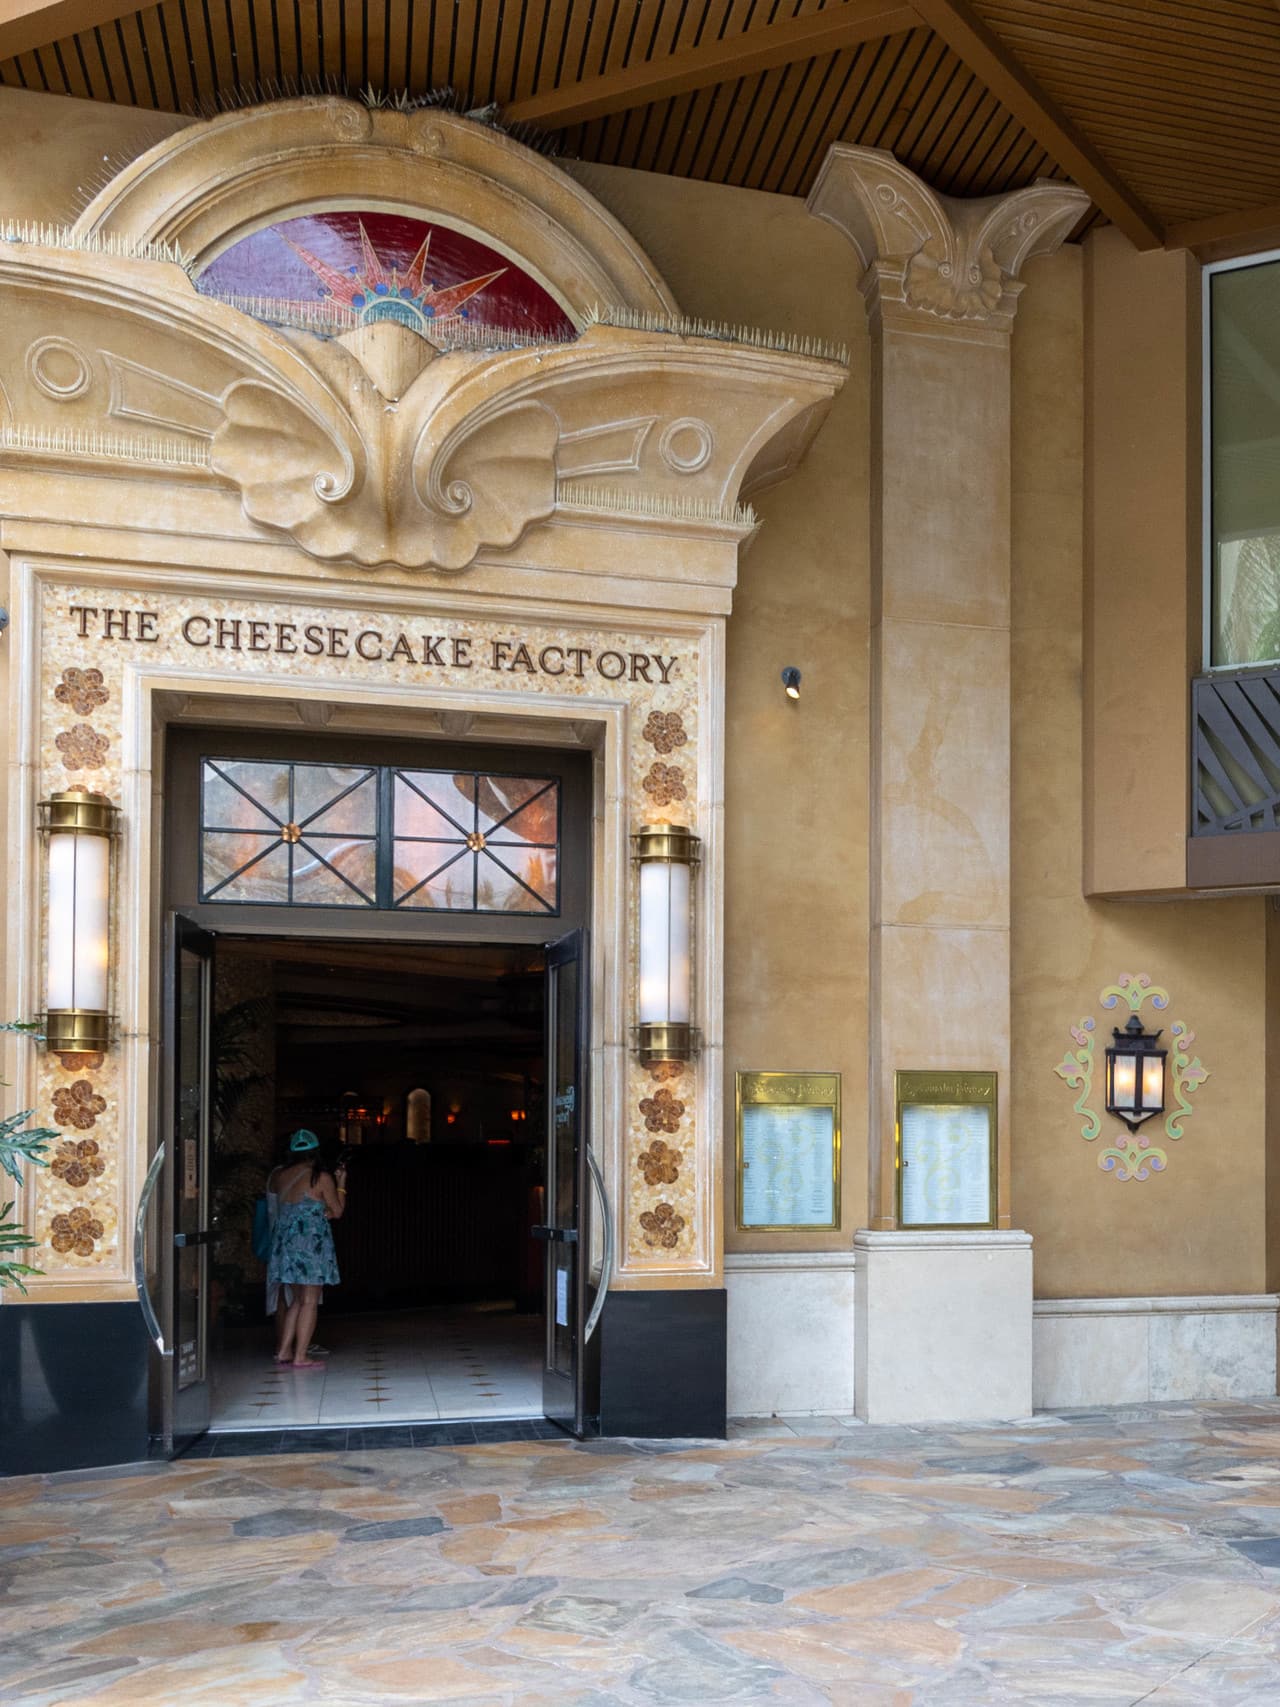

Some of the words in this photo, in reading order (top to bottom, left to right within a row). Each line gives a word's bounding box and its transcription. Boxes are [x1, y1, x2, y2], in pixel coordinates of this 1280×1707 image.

[69, 605, 160, 643] THE
[181, 615, 473, 669] CHEESECAKE
[490, 640, 678, 685] FACTORY
